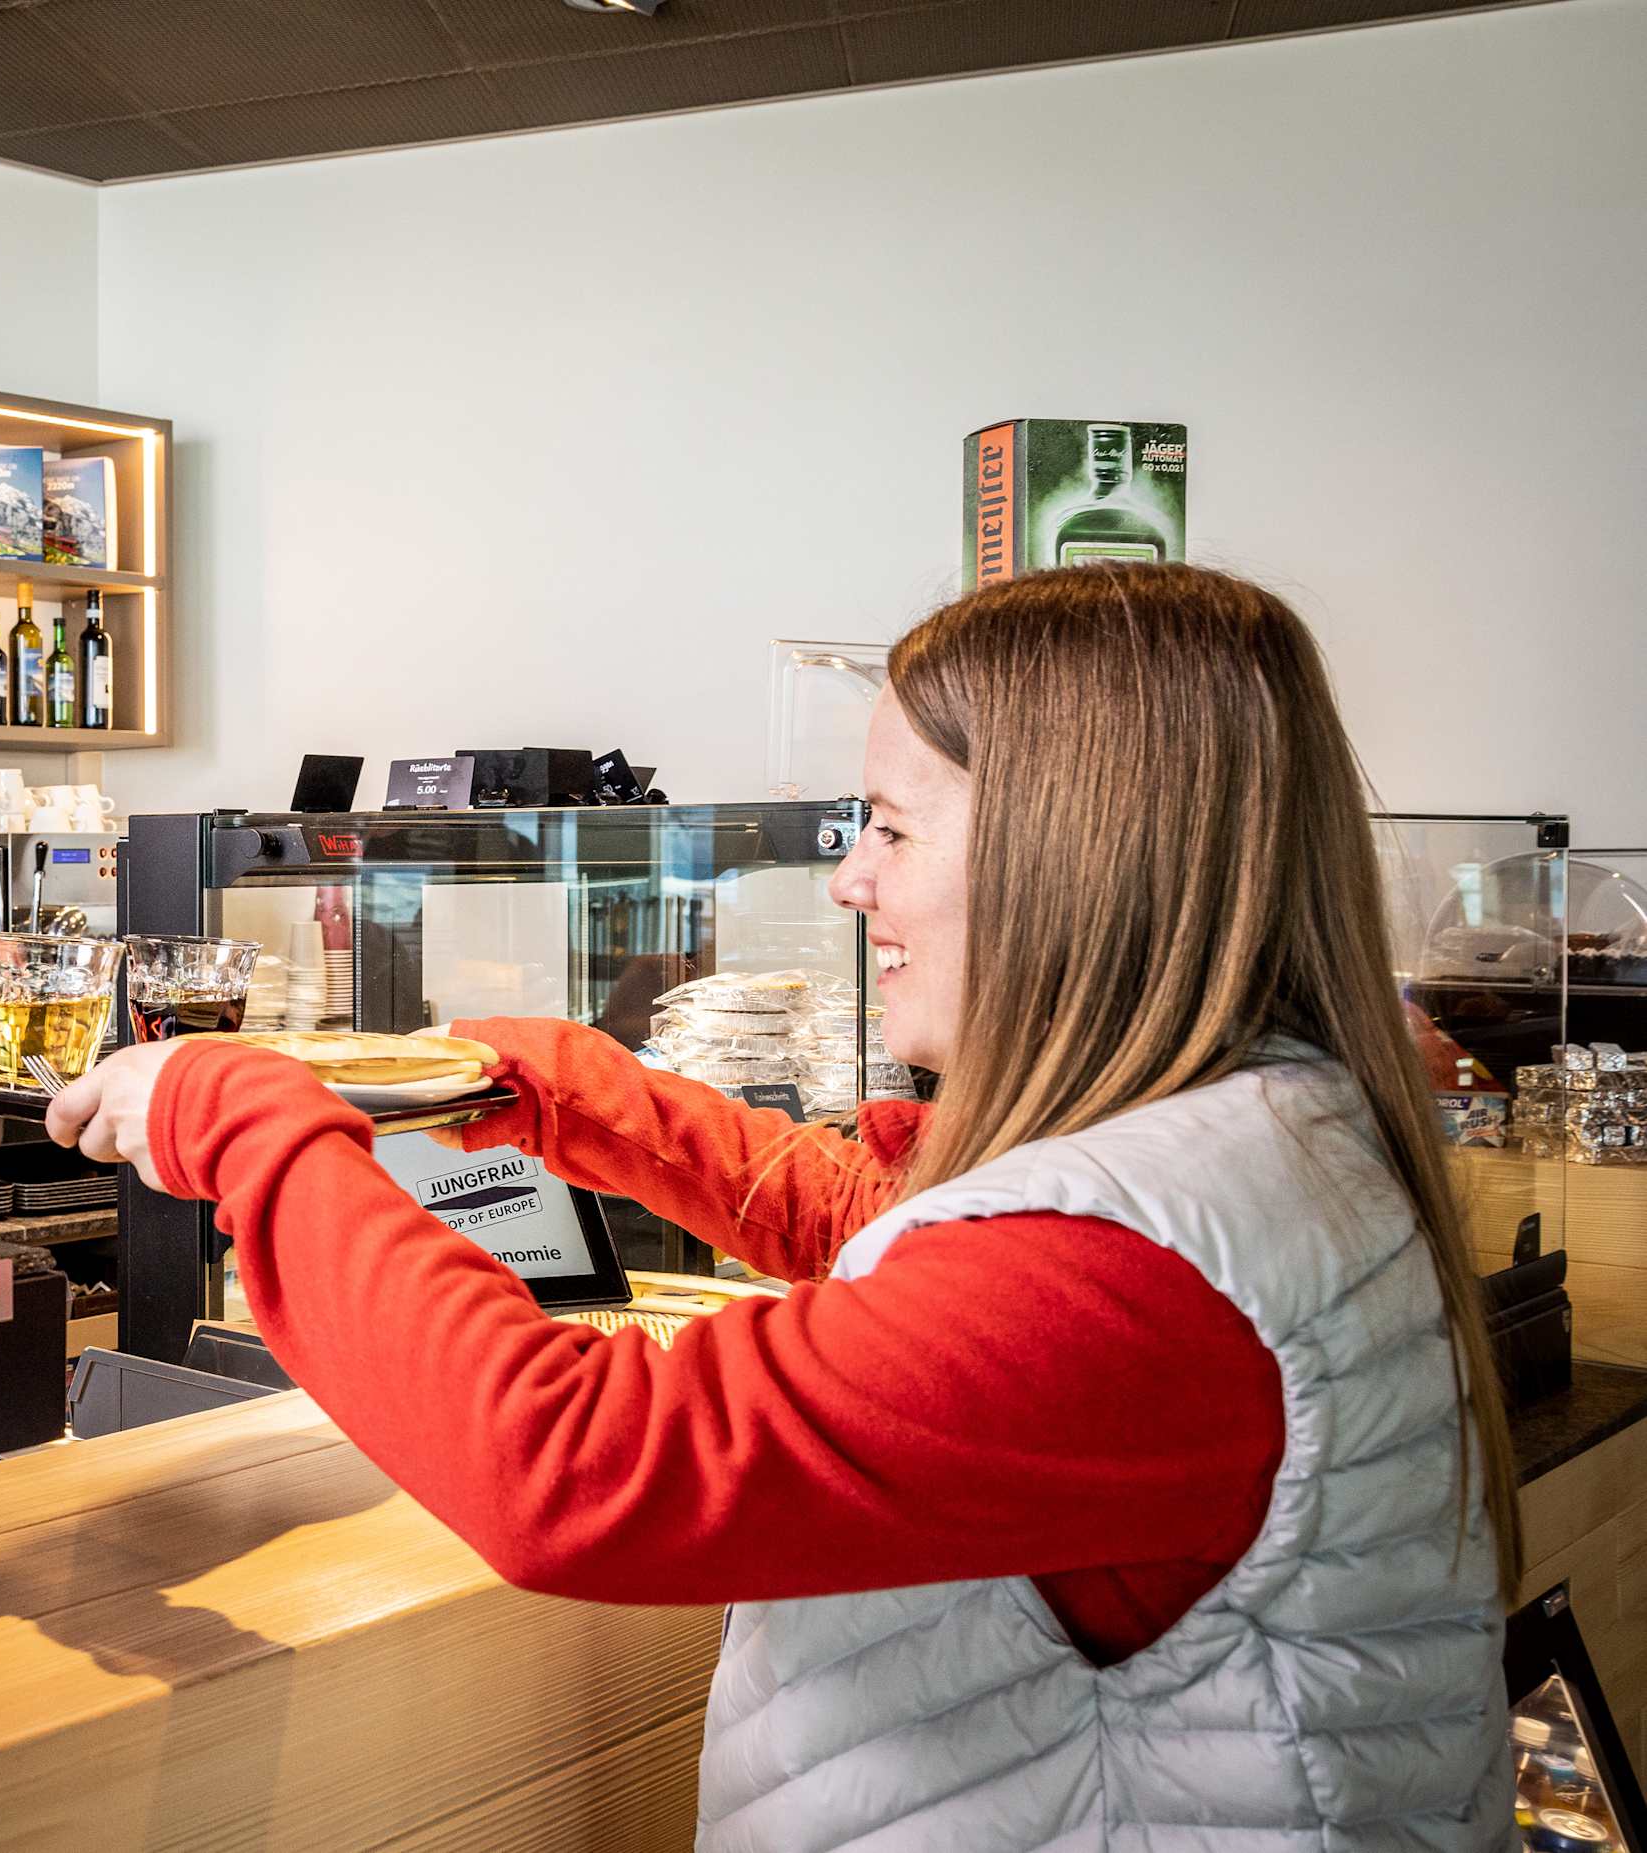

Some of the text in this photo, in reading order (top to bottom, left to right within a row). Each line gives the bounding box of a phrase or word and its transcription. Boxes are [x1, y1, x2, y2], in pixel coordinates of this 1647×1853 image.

[1142, 454, 1185, 463] AUTOMAT
[979, 446, 1008, 578] meister
[416, 784, 437, 795] 5.00
[430, 1159, 525, 1199] JUNGFRAU
[444, 1198, 537, 1231] OP OF EUROPE
